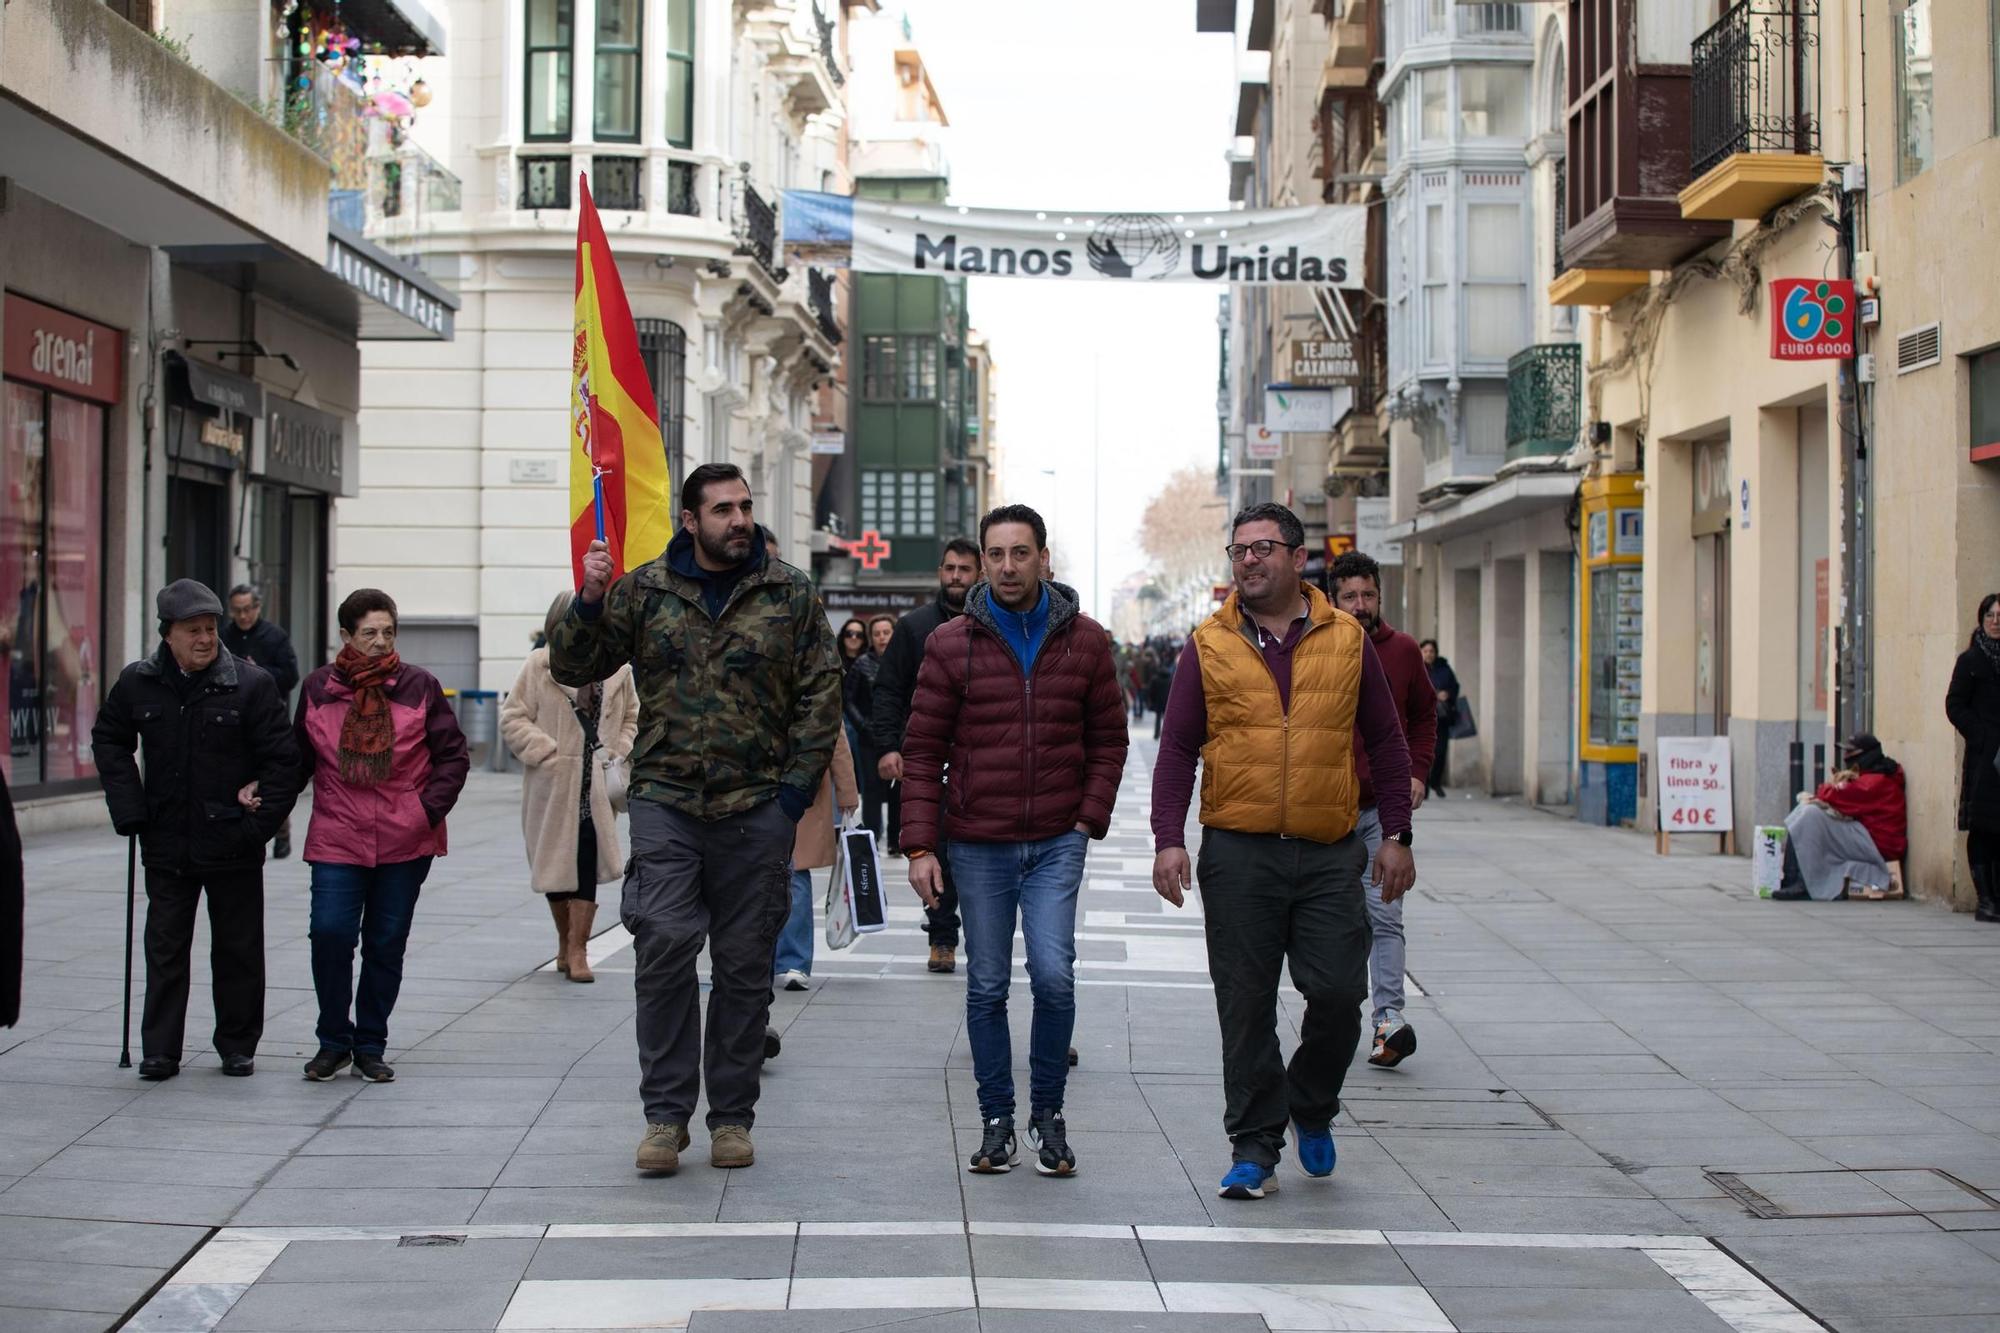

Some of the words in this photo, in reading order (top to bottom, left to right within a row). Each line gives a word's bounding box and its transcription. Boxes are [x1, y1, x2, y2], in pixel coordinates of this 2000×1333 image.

[914, 233, 1073, 276] Manos
[1191, 244, 1347, 283] Unidas
[32, 328, 94, 386] arenal
[1301, 341, 1352, 359] TEJIDOS
[1780, 343, 1814, 355] EURO
[1816, 343, 1851, 355] 6000
[1670, 757, 1702, 769] fibra
[1709, 763, 1718, 774] y
